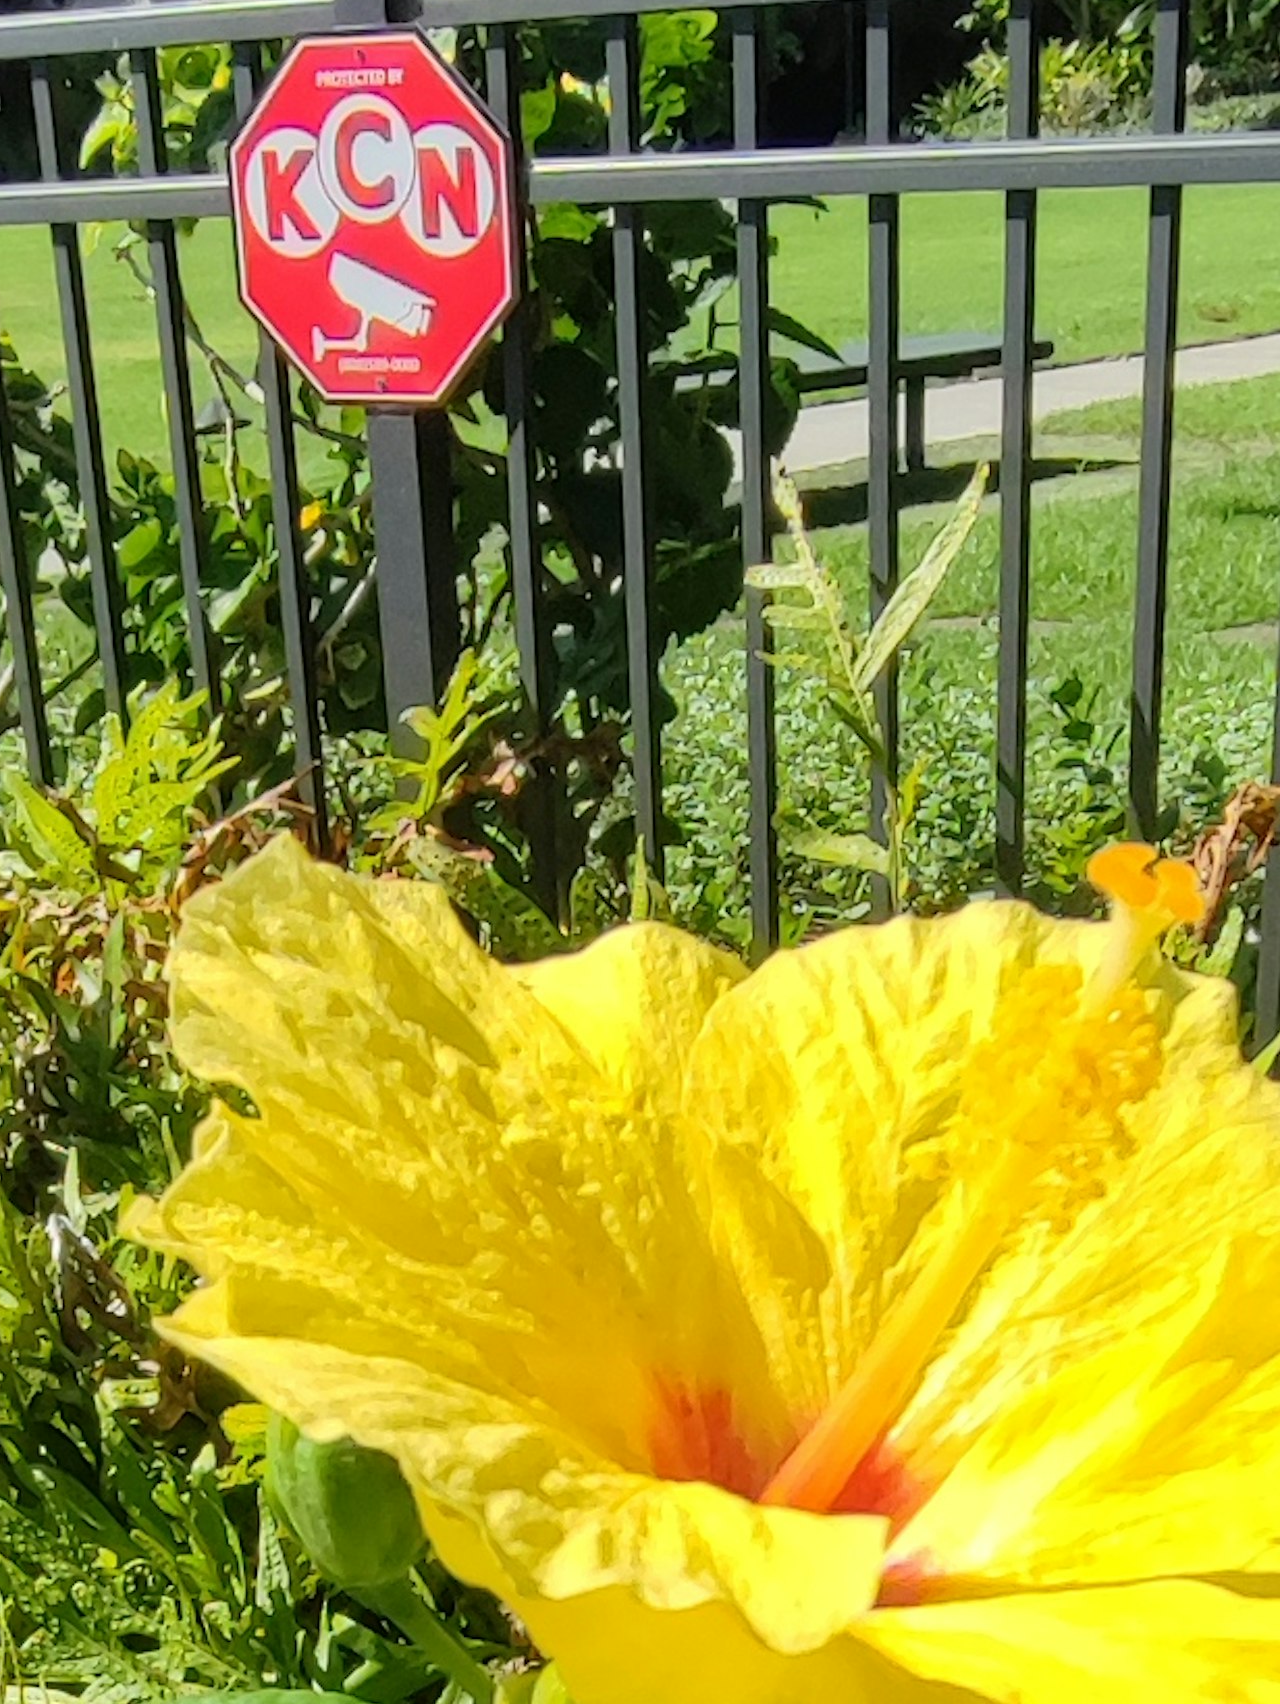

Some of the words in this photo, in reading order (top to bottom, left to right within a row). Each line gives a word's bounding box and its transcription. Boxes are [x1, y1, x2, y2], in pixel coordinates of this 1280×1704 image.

[315, 68, 385, 88] PROTECTED
[387, 67, 404, 86] BY
[261, 108, 479, 241] KCN
